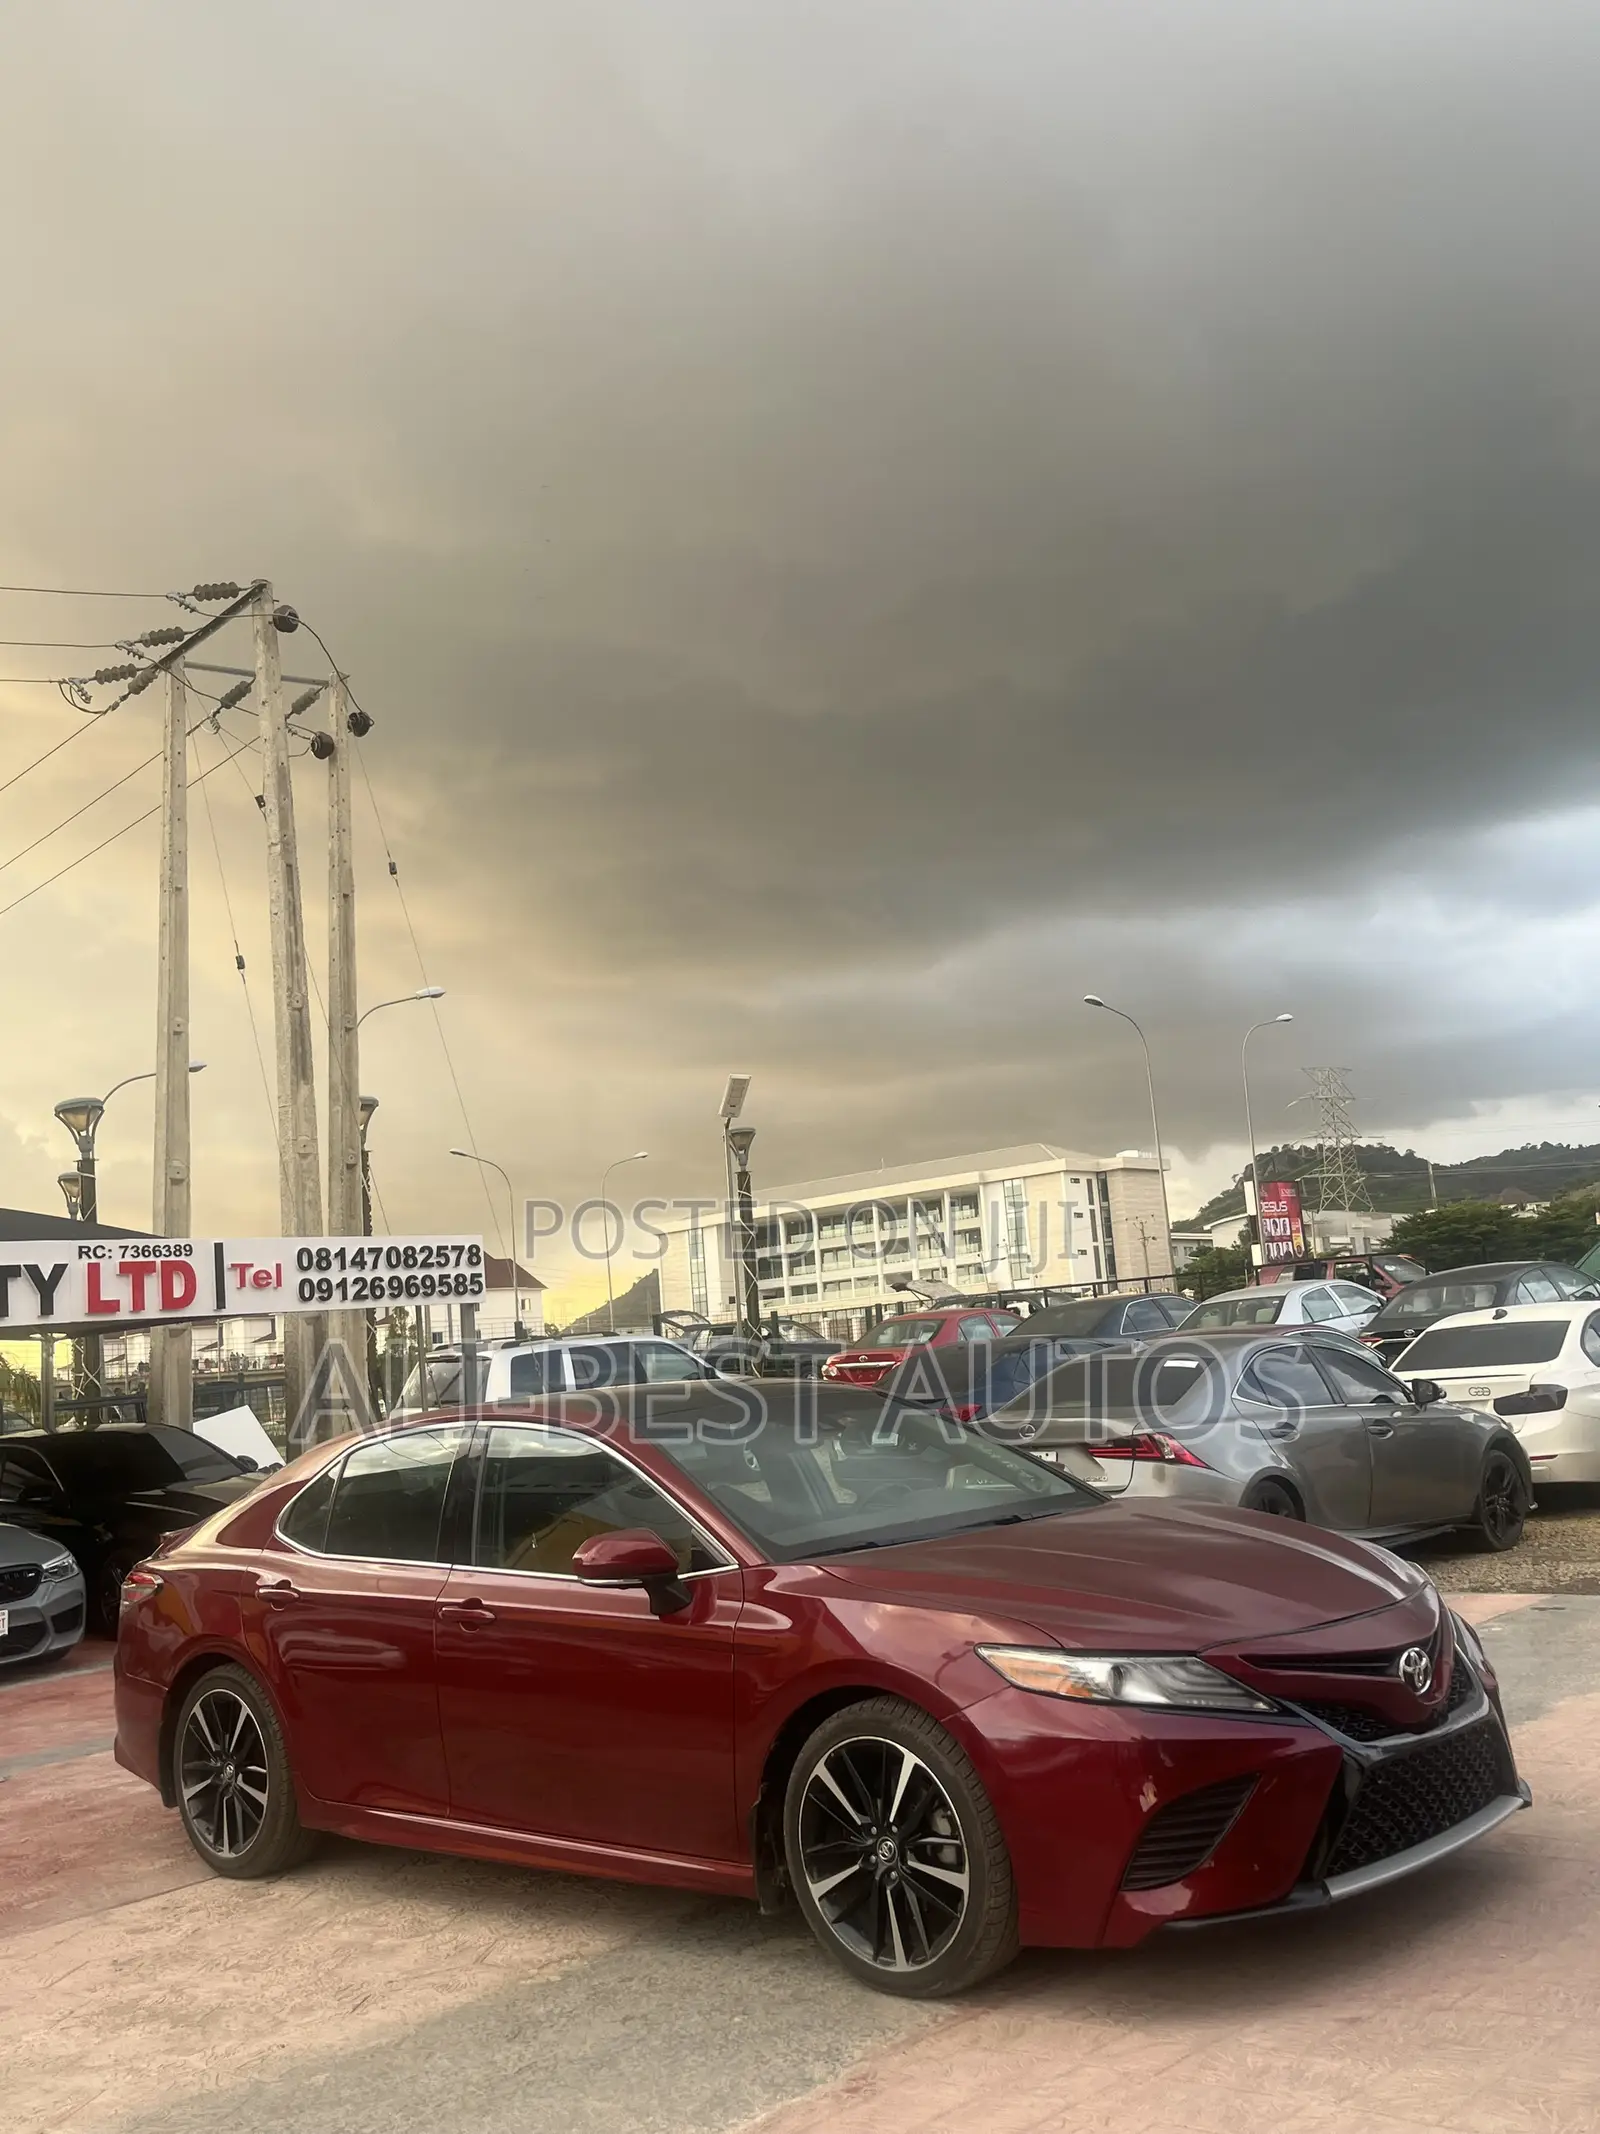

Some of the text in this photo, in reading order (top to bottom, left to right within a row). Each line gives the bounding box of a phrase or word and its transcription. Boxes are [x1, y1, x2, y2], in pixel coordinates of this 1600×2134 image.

[77, 1243, 194, 1260] RC: 7366389
[296, 1244, 482, 1271] 08147082578
[85, 1259, 198, 1315] LTD
[229, 1262, 282, 1289] Tel
[298, 1273, 484, 1301] 09126969585
